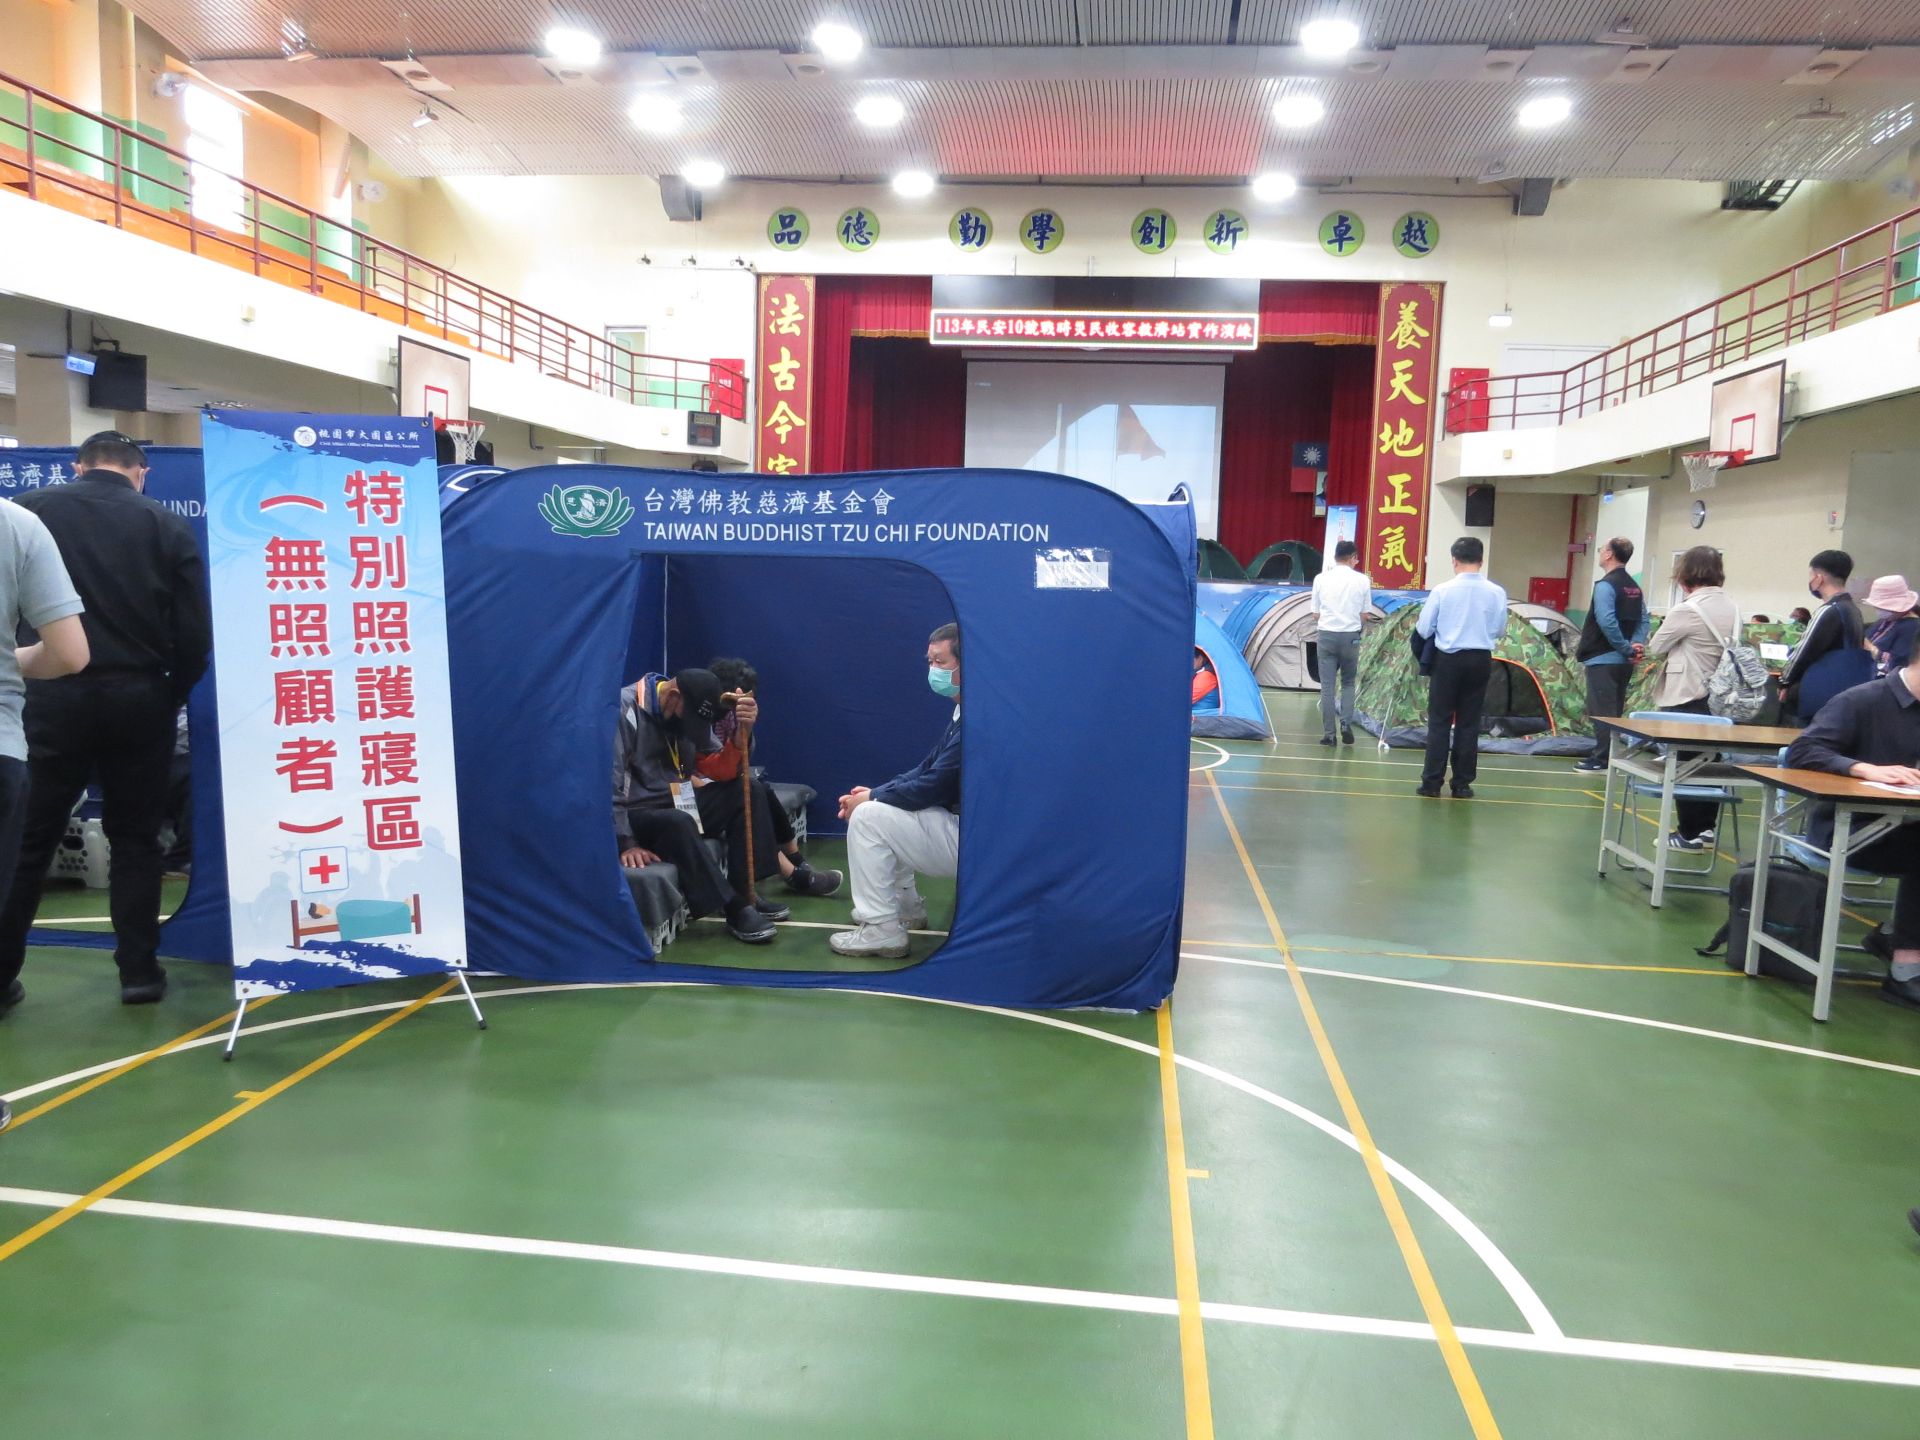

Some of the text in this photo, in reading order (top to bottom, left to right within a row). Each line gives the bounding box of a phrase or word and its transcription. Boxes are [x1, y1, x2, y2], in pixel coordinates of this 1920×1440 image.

[773, 212, 1431, 252] 品德 勤學 創新 卓越
[1378, 301, 1430, 572] 養天地正氣
[0, 462, 80, 489] 慈濟基
[644, 487, 896, 515] 台灣佛教慈濟基金會
[643, 522, 1049, 543] TAIWAN BUDDHIST TZU CHI FOUNDATION
[343, 469, 423, 850] 特別照護寢區
